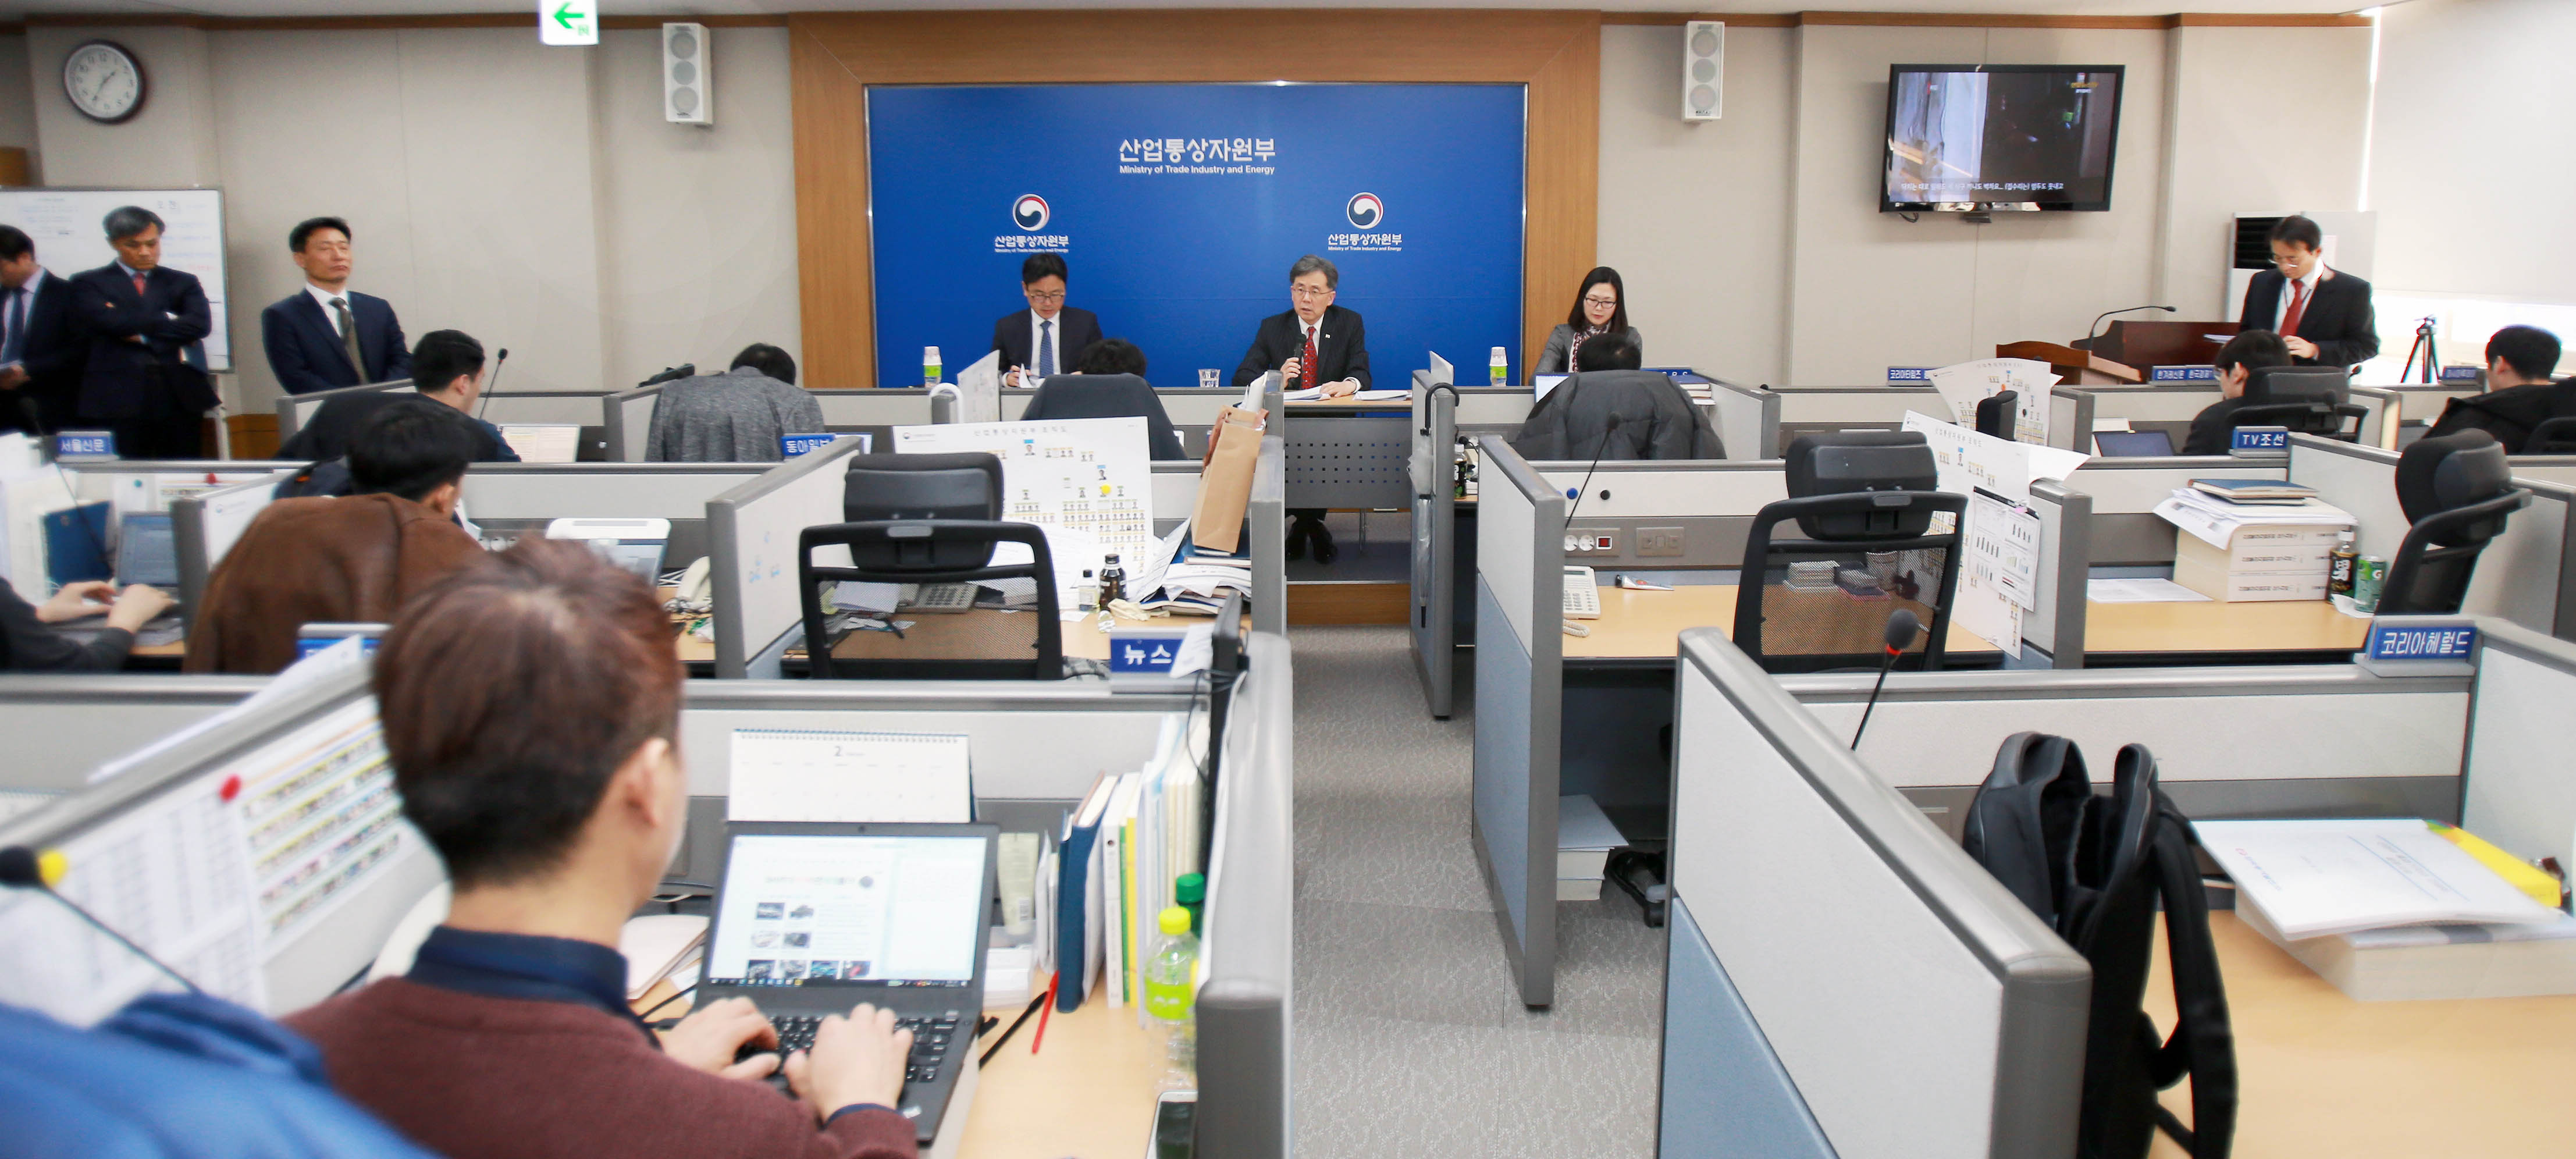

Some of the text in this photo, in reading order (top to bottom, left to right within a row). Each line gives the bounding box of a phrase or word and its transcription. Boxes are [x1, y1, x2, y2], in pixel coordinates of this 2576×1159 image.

[1119, 138, 1276, 163] 산업통상자원부
[1119, 165, 1152, 175] Ministry
[1165, 165, 1189, 173] Trade
[1191, 165, 1225, 175] Industry
[1227, 165, 1243, 173] and
[1246, 166, 1275, 175] Energy
[995, 235, 1069, 248] 산업통상자원부
[1328, 233, 1402, 246] 산업통상자원부
[1890, 369, 1921, 379] 코리아타임즈
[61, 439, 104, 451] 서울신문
[2243, 433, 2284, 446] TV조선
[2381, 631, 2470, 655] 코리아헤럴드
[1124, 644, 1172, 665] 뉴스
